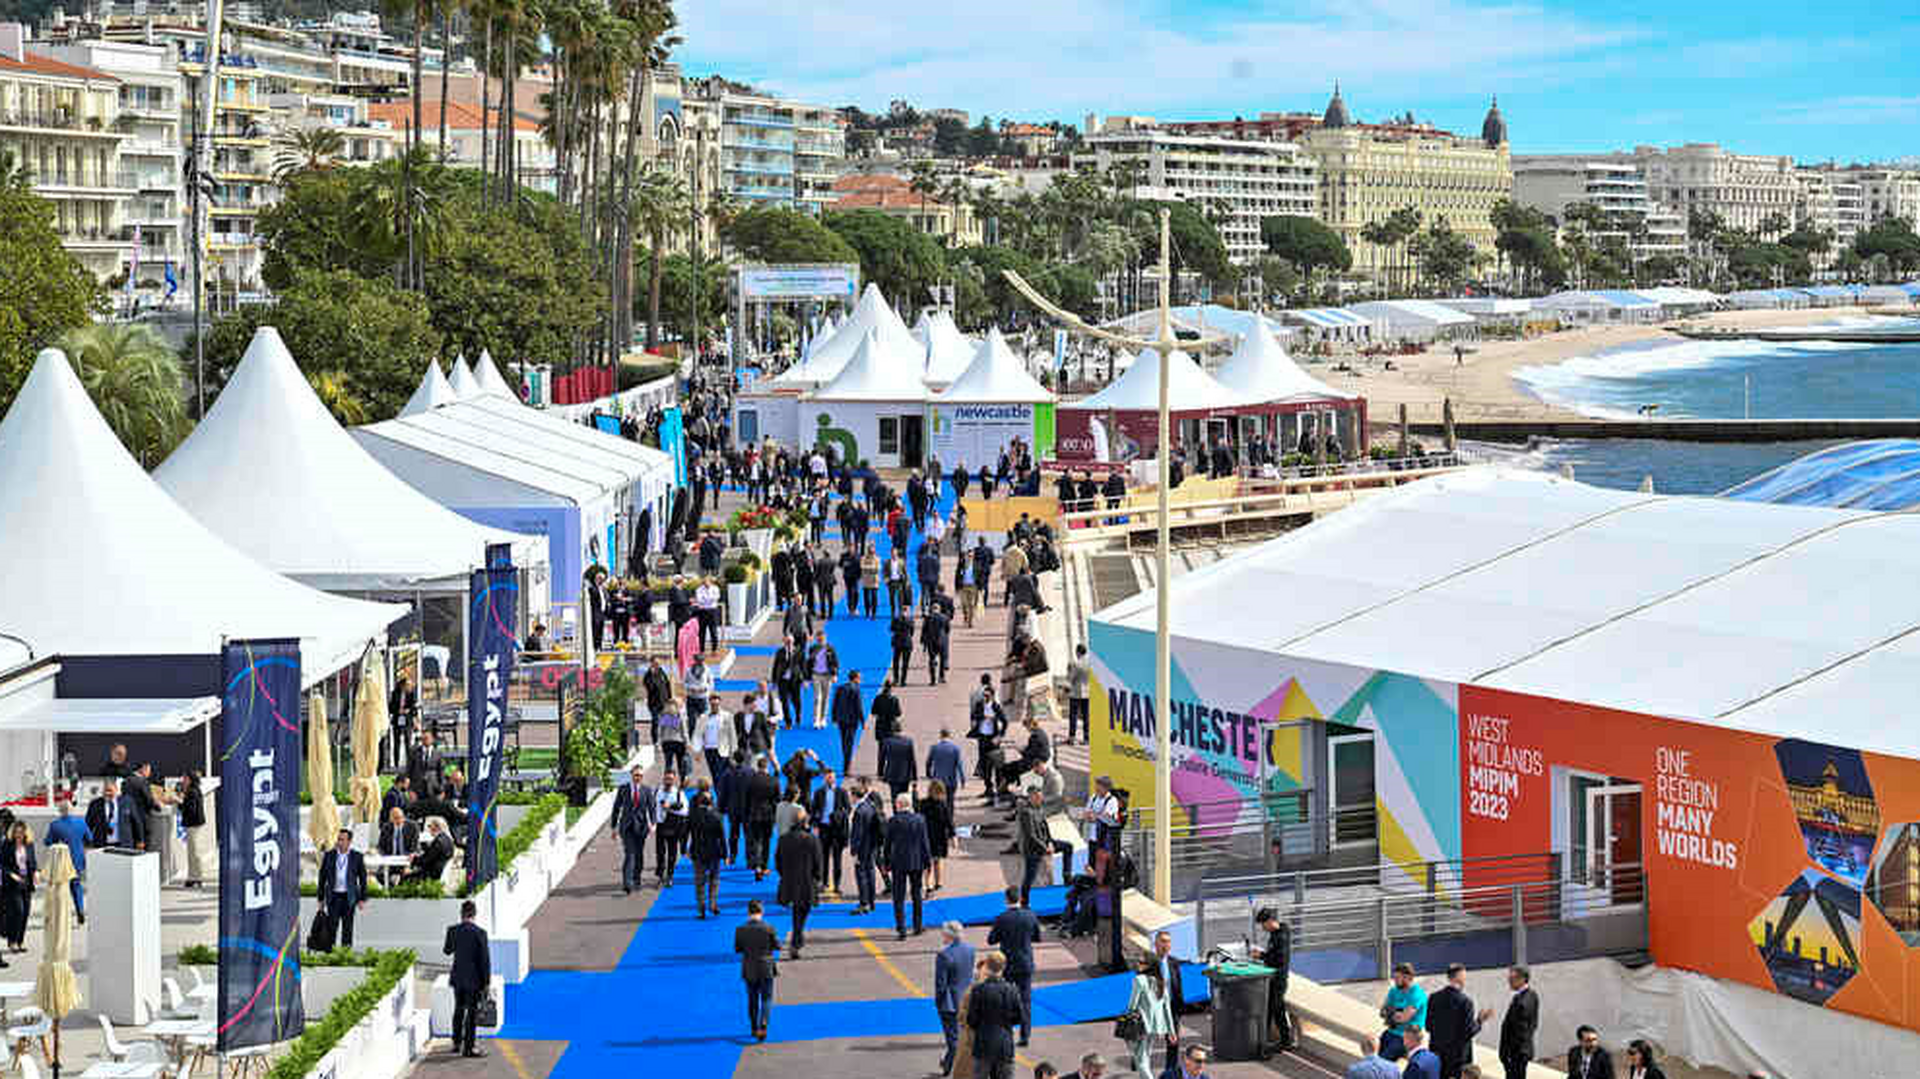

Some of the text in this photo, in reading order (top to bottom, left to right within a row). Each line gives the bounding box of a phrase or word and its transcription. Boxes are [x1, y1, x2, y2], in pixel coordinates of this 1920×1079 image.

[955, 404, 1031, 419] newcastle
[477, 653, 502, 781] Egypt
[1467, 713, 1509, 743] WEST
[1469, 740, 1543, 776] MIDLANDS
[1655, 746, 1691, 777] ONE
[1469, 765, 1518, 799] MIPIM
[1657, 774, 1718, 810] REGION
[1469, 790, 1508, 820] 2023
[1657, 801, 1713, 838] MANY
[245, 747, 281, 910] Egypt
[1657, 828, 1738, 869] WORLDS
